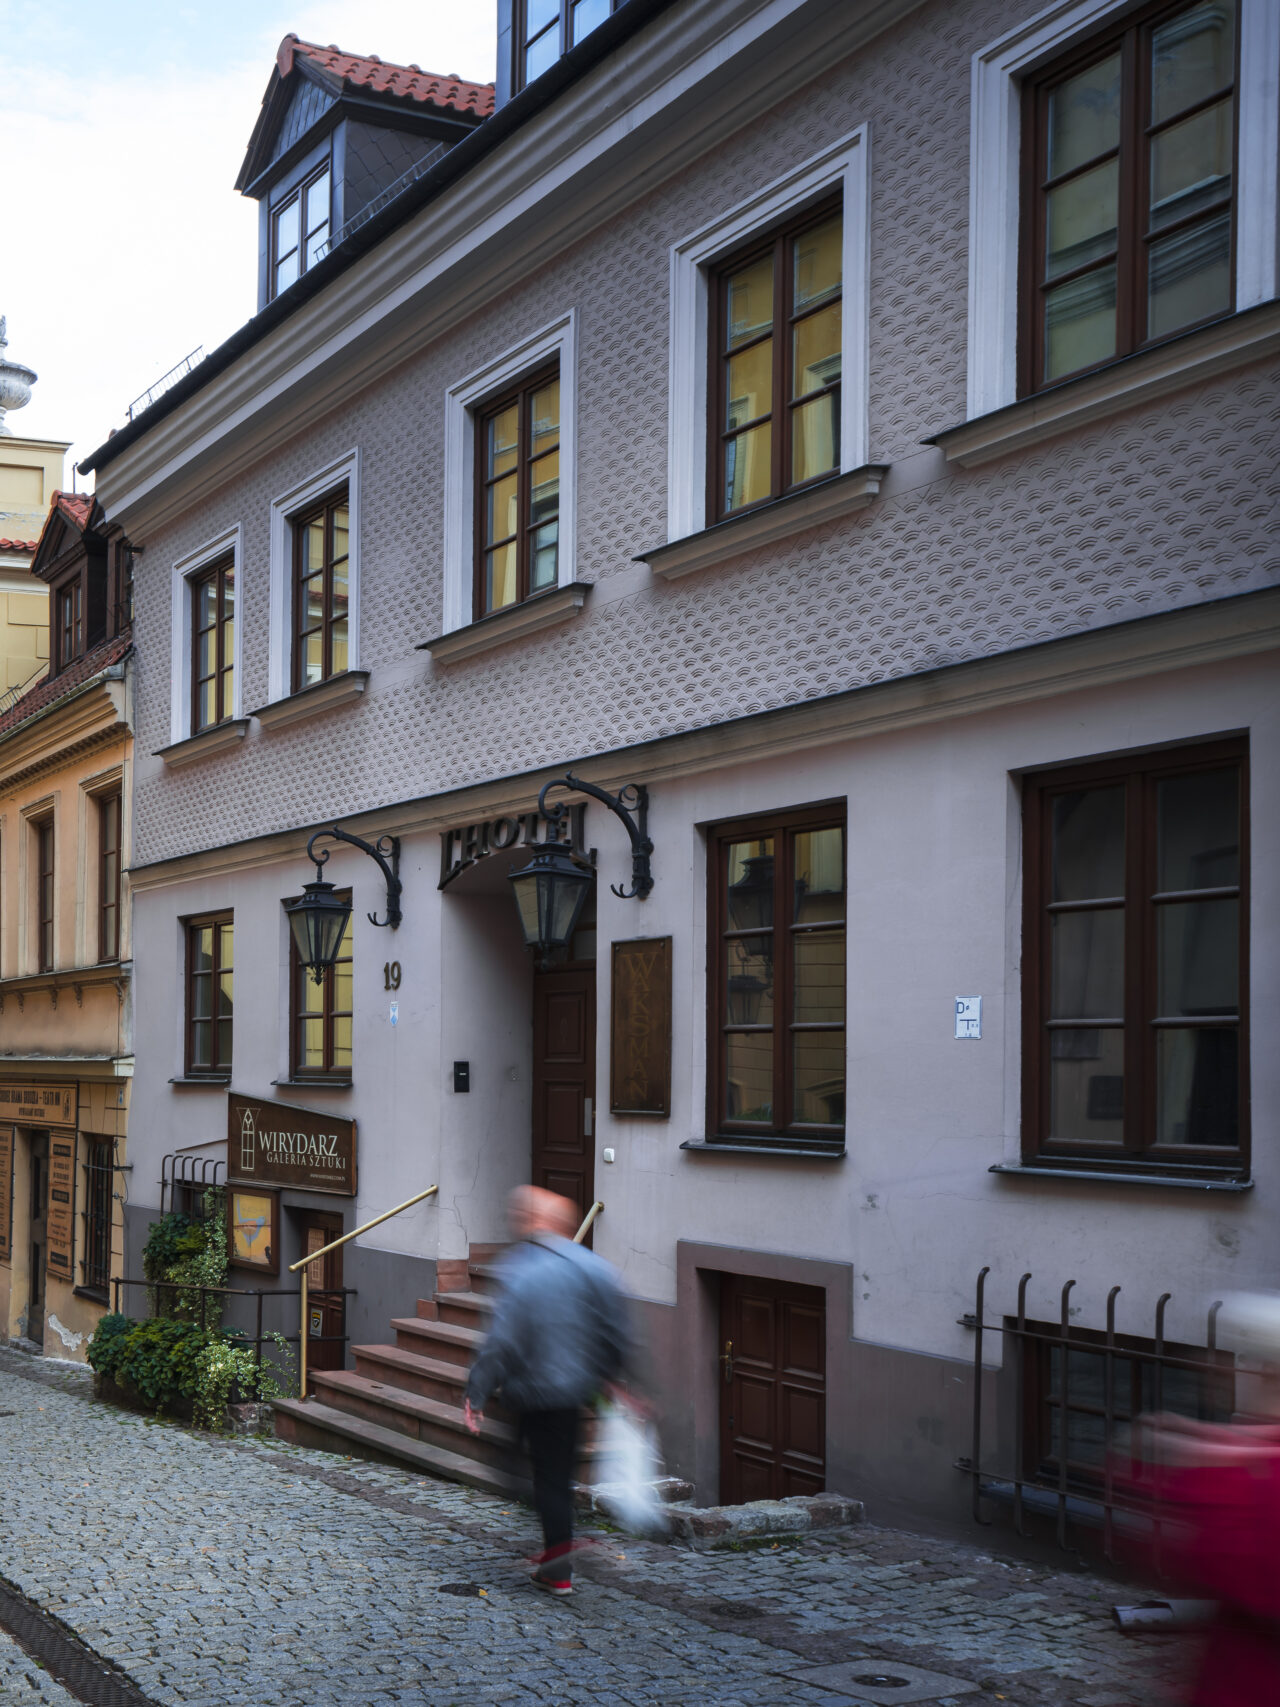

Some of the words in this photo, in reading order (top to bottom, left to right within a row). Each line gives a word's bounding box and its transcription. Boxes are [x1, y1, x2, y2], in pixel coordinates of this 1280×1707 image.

[384, 961, 402, 991] 19
[622, 952, 658, 1100] WAKSMAN
[259, 1131, 338, 1156] WIRYDARZ
[266, 1151, 307, 1166] GALERIA
[309, 1155, 346, 1169] SZTUKI
